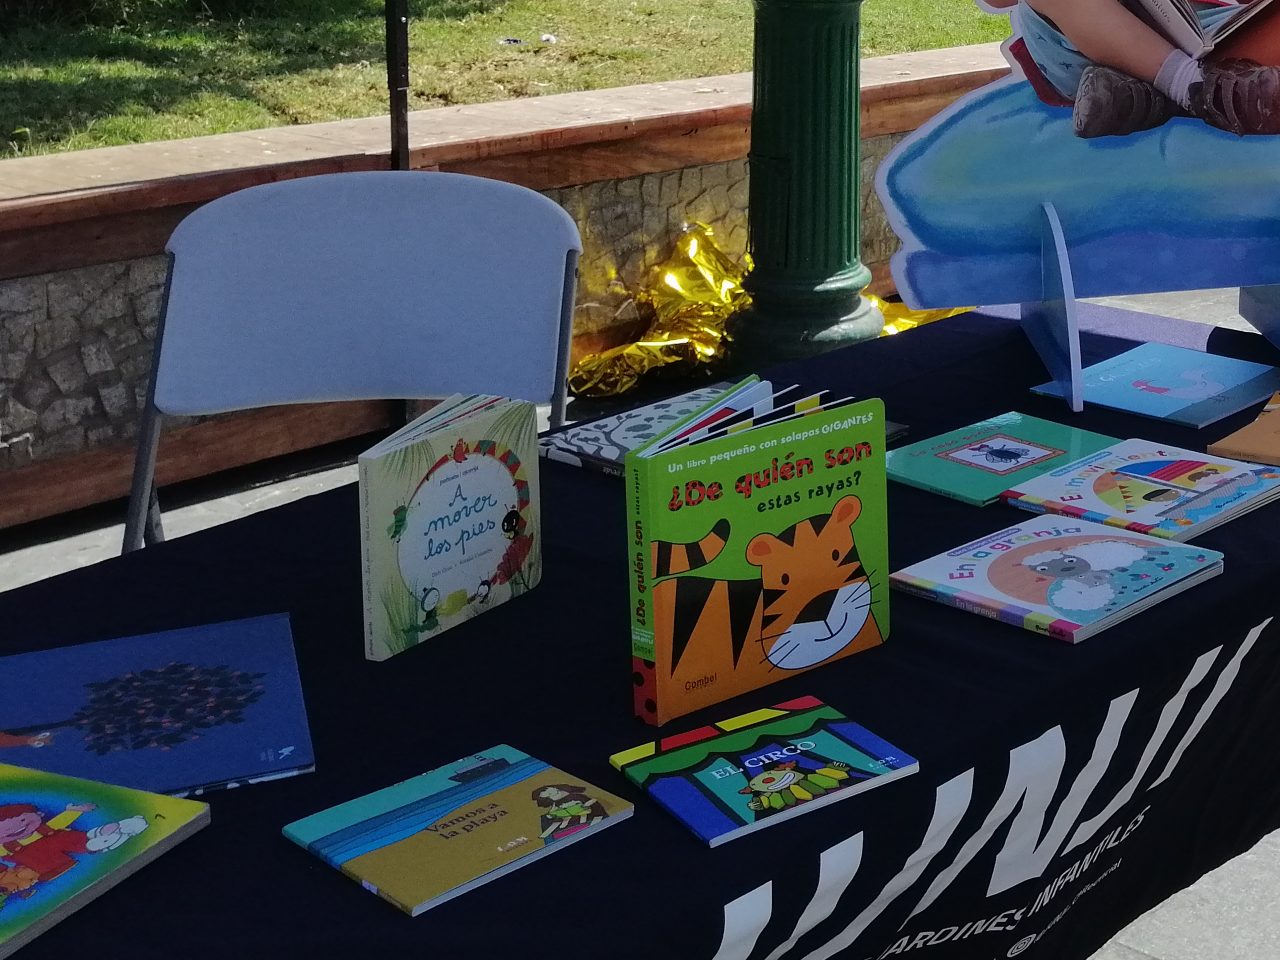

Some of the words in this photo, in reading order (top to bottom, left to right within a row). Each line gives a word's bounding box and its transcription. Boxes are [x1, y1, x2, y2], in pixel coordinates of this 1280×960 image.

[667, 462, 683, 474] Un
[686, 457, 707, 469] libro
[709, 444, 756, 466] pequeño
[759, 438, 778, 452] con
[780, 427, 820, 447] solapas
[821, 412, 874, 435] GIGANTES
[449, 483, 467, 507] A
[667, 479, 724, 512] ¿De
[734, 451, 814, 499] quién
[824, 441, 872, 469] son
[757, 490, 801, 513] estas
[808, 470, 862, 500] rayas?
[423, 492, 497, 536] mover
[634, 520, 643, 547] son
[423, 538, 451, 561] los
[455, 517, 496, 556] pies
[948, 563, 976, 580] En
[989, 525, 1082, 552] granja
[633, 552, 646, 594] quién
[955, 598, 965, 609] En
[973, 605, 998, 619] granja
[684, 672, 717, 690] Combel
[711, 766, 744, 780] EL
[744, 741, 816, 768] CIRCO
[425, 805, 487, 834] Vamos
[488, 801, 498, 810] a
[440, 828, 459, 840] la
[462, 808, 509, 835] playa
[1027, 805, 1151, 918] INFANTILES
